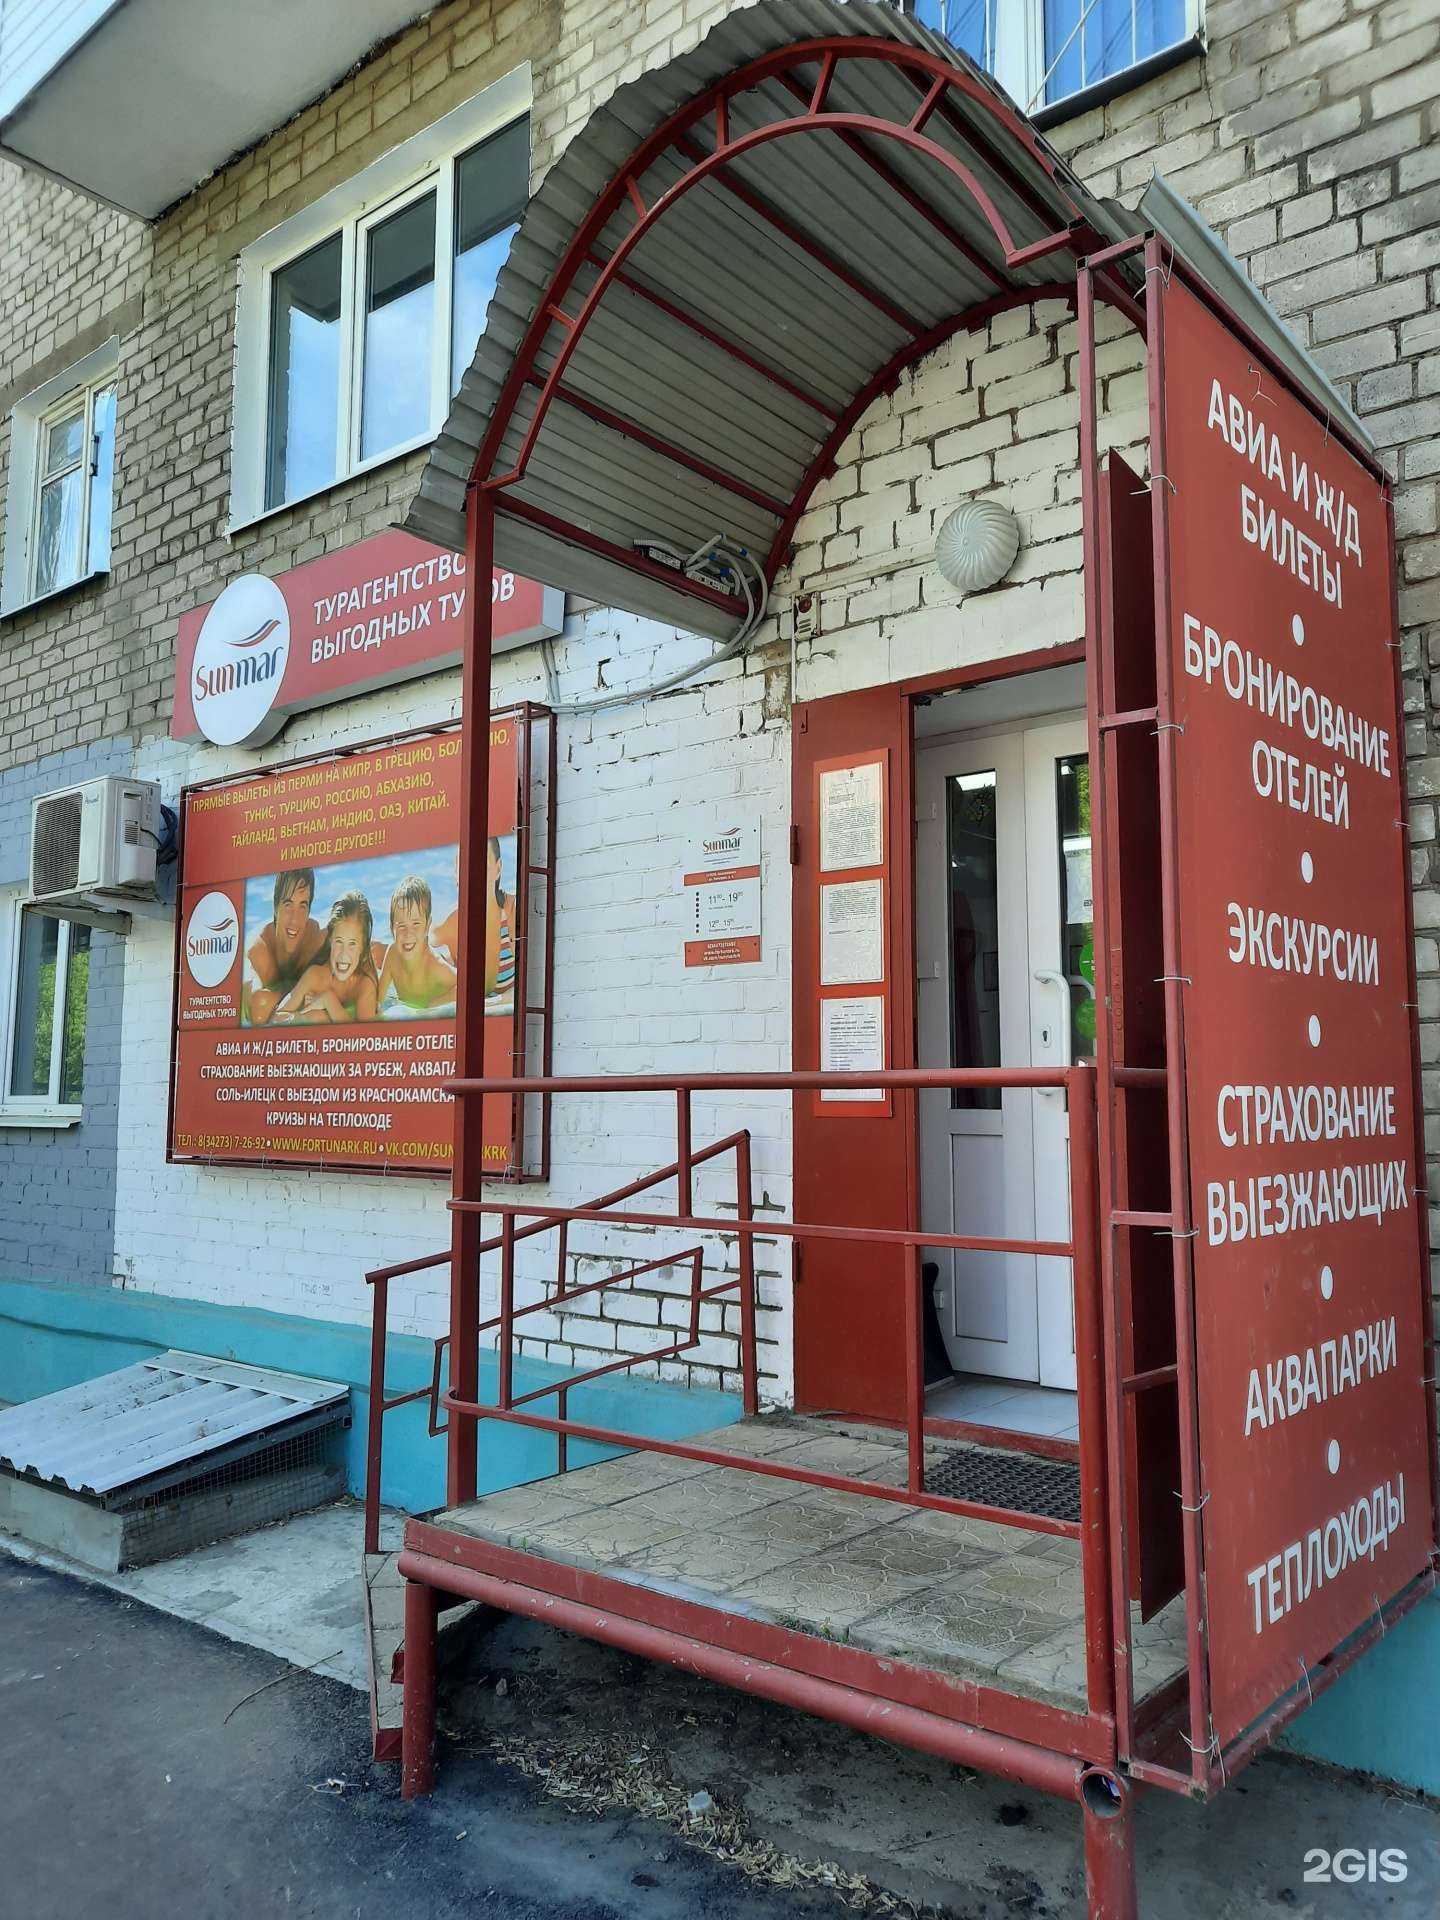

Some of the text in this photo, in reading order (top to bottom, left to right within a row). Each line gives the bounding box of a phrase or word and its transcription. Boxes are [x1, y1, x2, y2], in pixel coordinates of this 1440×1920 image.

[1207, 378, 1362, 567] АВИА И Ж/Д
[1241, 484, 1343, 610] БИЛЕТЫ
[311, 608, 432, 664] ВЫГОДНЫХ
[194, 646, 285, 701] Sunmar
[1184, 612, 1391, 778] БРОНИРОВАНИЕ
[193, 792, 231, 813] ПРЯМЫЕ
[232, 784, 271, 805] ВЫЛЕТЫ
[274, 781, 286, 795] ИЗ
[288, 771, 323, 790] ПЕРМИ
[325, 768, 340, 782] НА
[342, 762, 373, 780] КИПР,
[375, 759, 383, 772] В
[385, 746, 435, 769] ГРЕЦИЮ,
[244, 772, 434, 825] ТУНИС, ТУРЦИЮ, РОССИЮ, АБХАЗИЮ,
[1252, 740, 1350, 830] ОТЕЛЕЙ
[232, 790, 450, 848] ТАЙЛАНД, ВЬЕТНАМ, ИНДИЮ, ОАЭ, КИТАЙ.
[280, 829, 386, 861] И МНОГОЕ ДРУГОЕ!!!
[703, 836, 743, 852] Sunmar
[188, 934, 236, 957] Sunmar
[1227, 902, 1380, 986] ЭКСКУРСИИ
[183, 1008, 237, 1021] ВЫГОДНЫХ ТУРОВ
[188, 995, 232, 1006] ТУРАГЕНТСТВО
[200, 1064, 265, 1079] СТРАХОВАНИЕ
[267, 1063, 345, 1080] ВЫЕЗЖАЮЩИХ
[348, 1063, 362, 1077] ЗА
[365, 1062, 406, 1079] РУБЕЖ,
[216, 1034, 457, 1057] АВИА И Ж/Д БИЛЕТЫ, БРОНИРОВАНИЕ ОТЕЛЕ
[216, 1088, 276, 1104] СОЛЬ-ИЛЕЦК
[278, 1088, 284, 1101] С
[287, 1088, 340, 1104] ВЫЕЗДОМ
[342, 1088, 357, 1102] ИЗ
[266, 1112, 393, 1131] КРУИЗЫ НА ТЕПЛОХОДЕ
[1217, 1084, 1397, 1147] СТРАХОВАНИЕ
[198, 1134, 232, 1150] 8(34273)
[234, 1137, 266, 1149] 7-26-92
[272, 1138, 377, 1154] WWW.FORTUNARK.RU
[1207, 1160, 1409, 1247] ВЫЕЗЖАЮЩИХ
[1244, 1316, 1397, 1437] АКВАПАРКИ
[1247, 1472, 1406, 1635] ТЕПЛОХОДЫ
